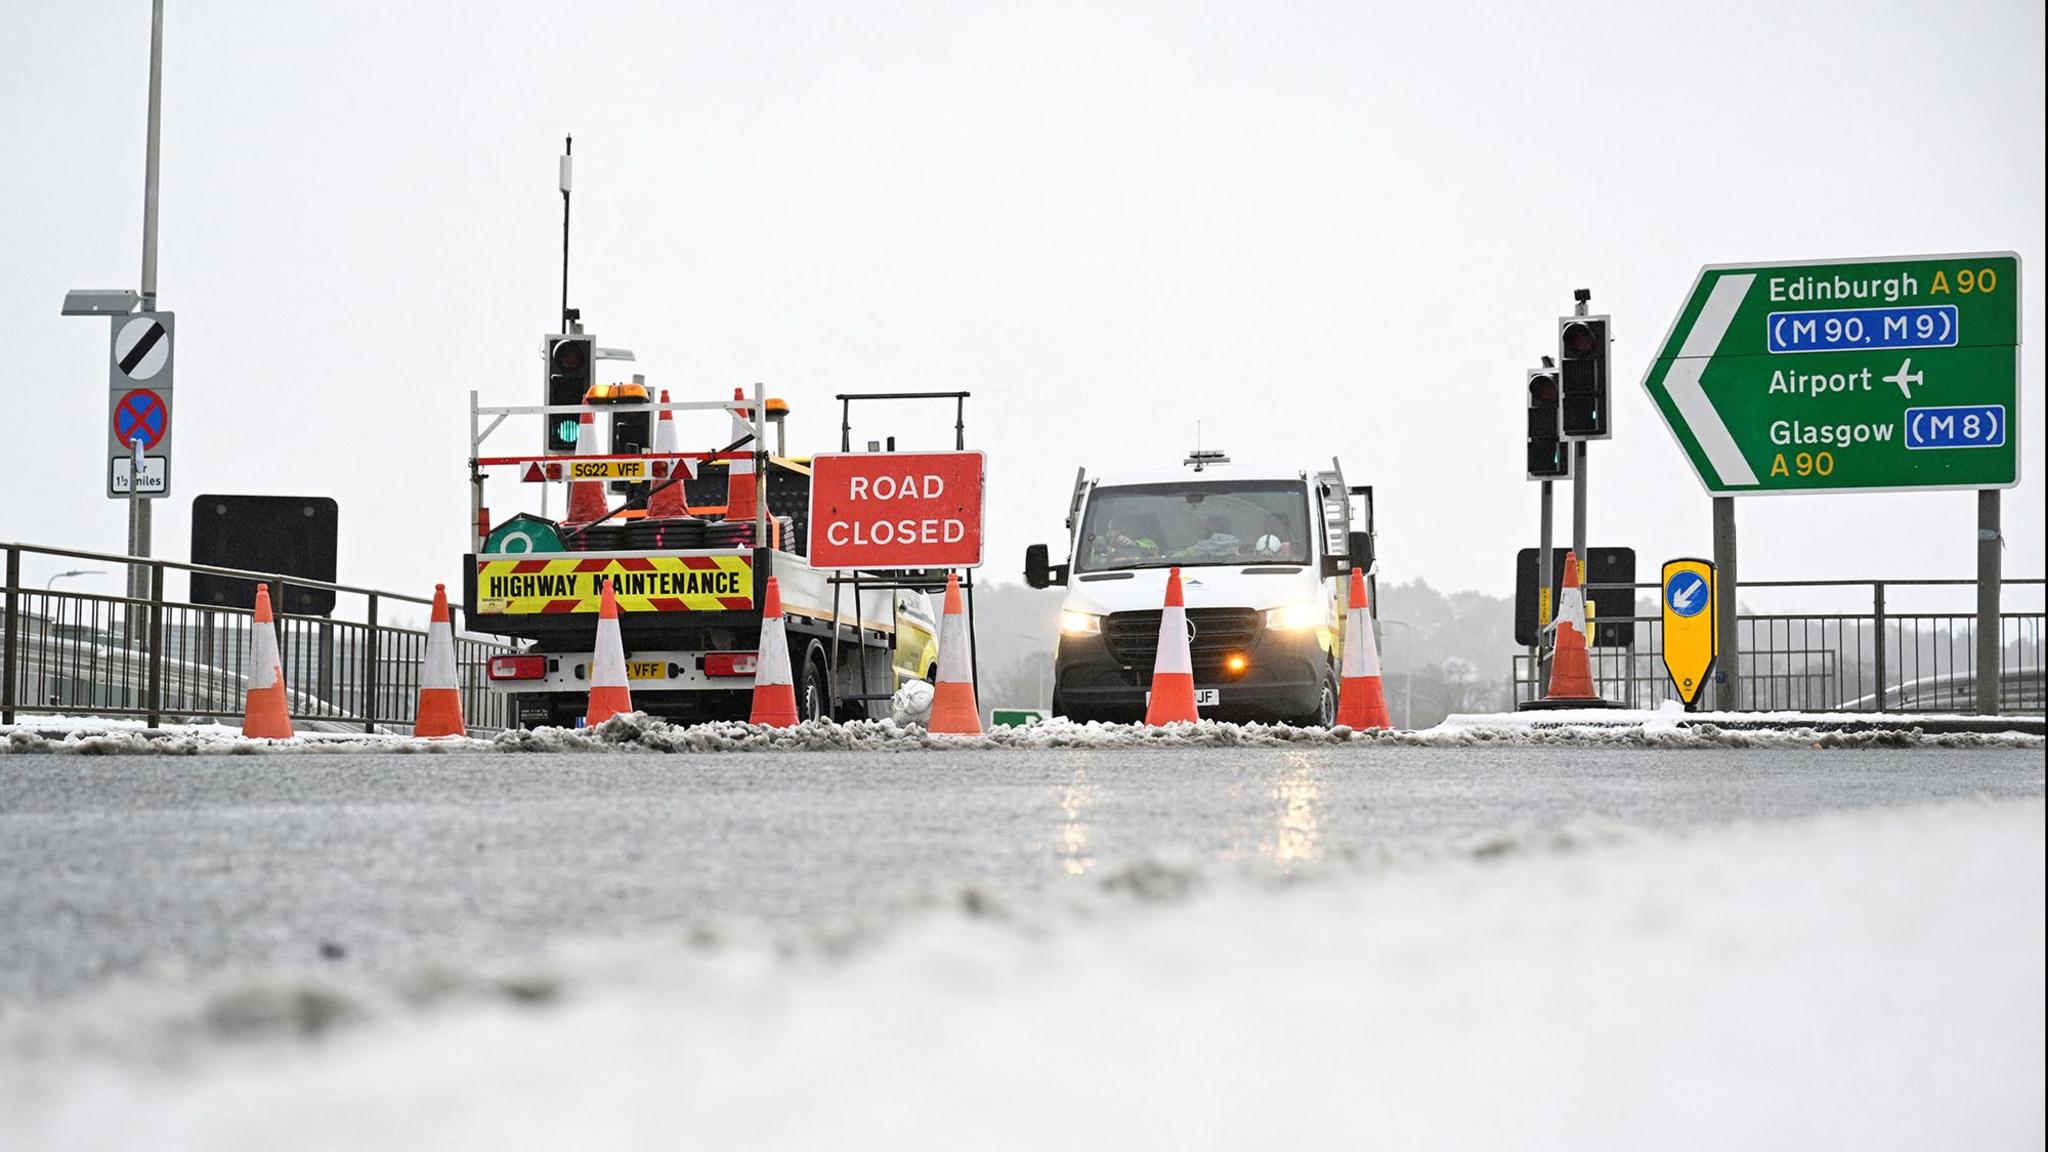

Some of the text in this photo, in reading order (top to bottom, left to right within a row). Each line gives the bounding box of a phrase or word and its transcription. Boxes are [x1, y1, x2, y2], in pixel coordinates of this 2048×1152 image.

[1769, 272, 1918, 302] Edinburgh
[1768, 368, 1872, 397] Airport
[1769, 420, 1894, 448] Glasgow
[575, 463, 640, 477] SG22 VFF
[850, 475, 944, 500] ROAD
[827, 519, 965, 546] CLOSED
[490, 574, 577, 598] HIGHWAY
[633, 663, 659, 677] VFF
